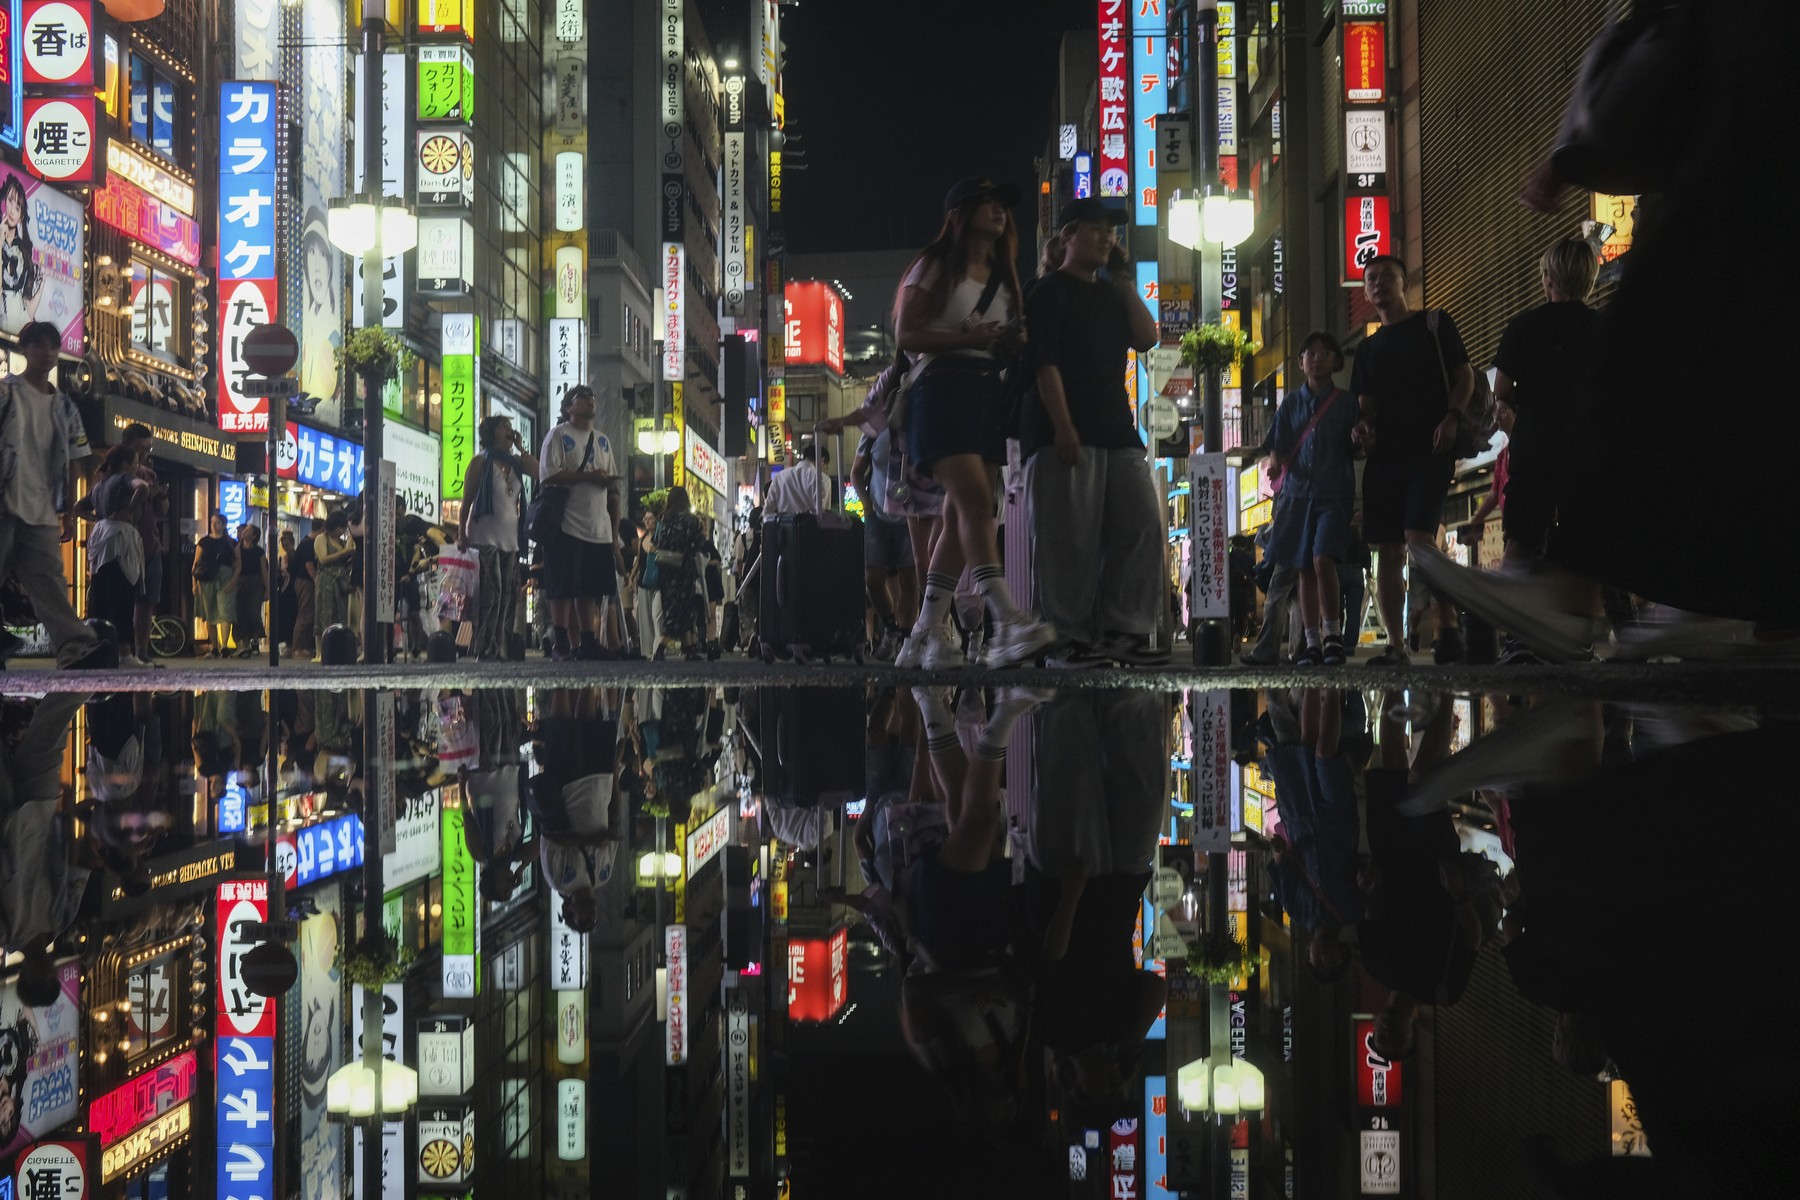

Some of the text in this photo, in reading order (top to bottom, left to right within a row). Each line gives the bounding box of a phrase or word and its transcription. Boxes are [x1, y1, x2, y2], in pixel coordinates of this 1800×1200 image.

[1342, 2, 1386, 15] more
[667, 14, 678, 45] Cafe
[668, 50, 678, 59] &
[426, 69, 437, 116] クォーク
[667, 63, 678, 116] Capsule
[725, 76, 743, 124] Booth
[34, 158, 82, 167] CIGARETTE
[225, 85, 272, 278] カラオケ
[442, 176, 460, 188] UP
[729, 139, 740, 253] ネットカフェ & カプセル
[1357, 174, 1376, 187] 3F
[432, 192, 447, 203] 4F
[664, 180, 682, 232] Booth
[434, 278, 447, 289] 3F
[667, 256, 679, 301] カラオケ
[67, 339, 82, 353] B1F
[221, 413, 269, 430] 直売所
[450, 380, 466, 494] カワノ・クォーク
[181, 431, 220, 457] SHINJUKU
[220, 444, 237, 462] ALE
[767, 424, 785, 462] CASINO
